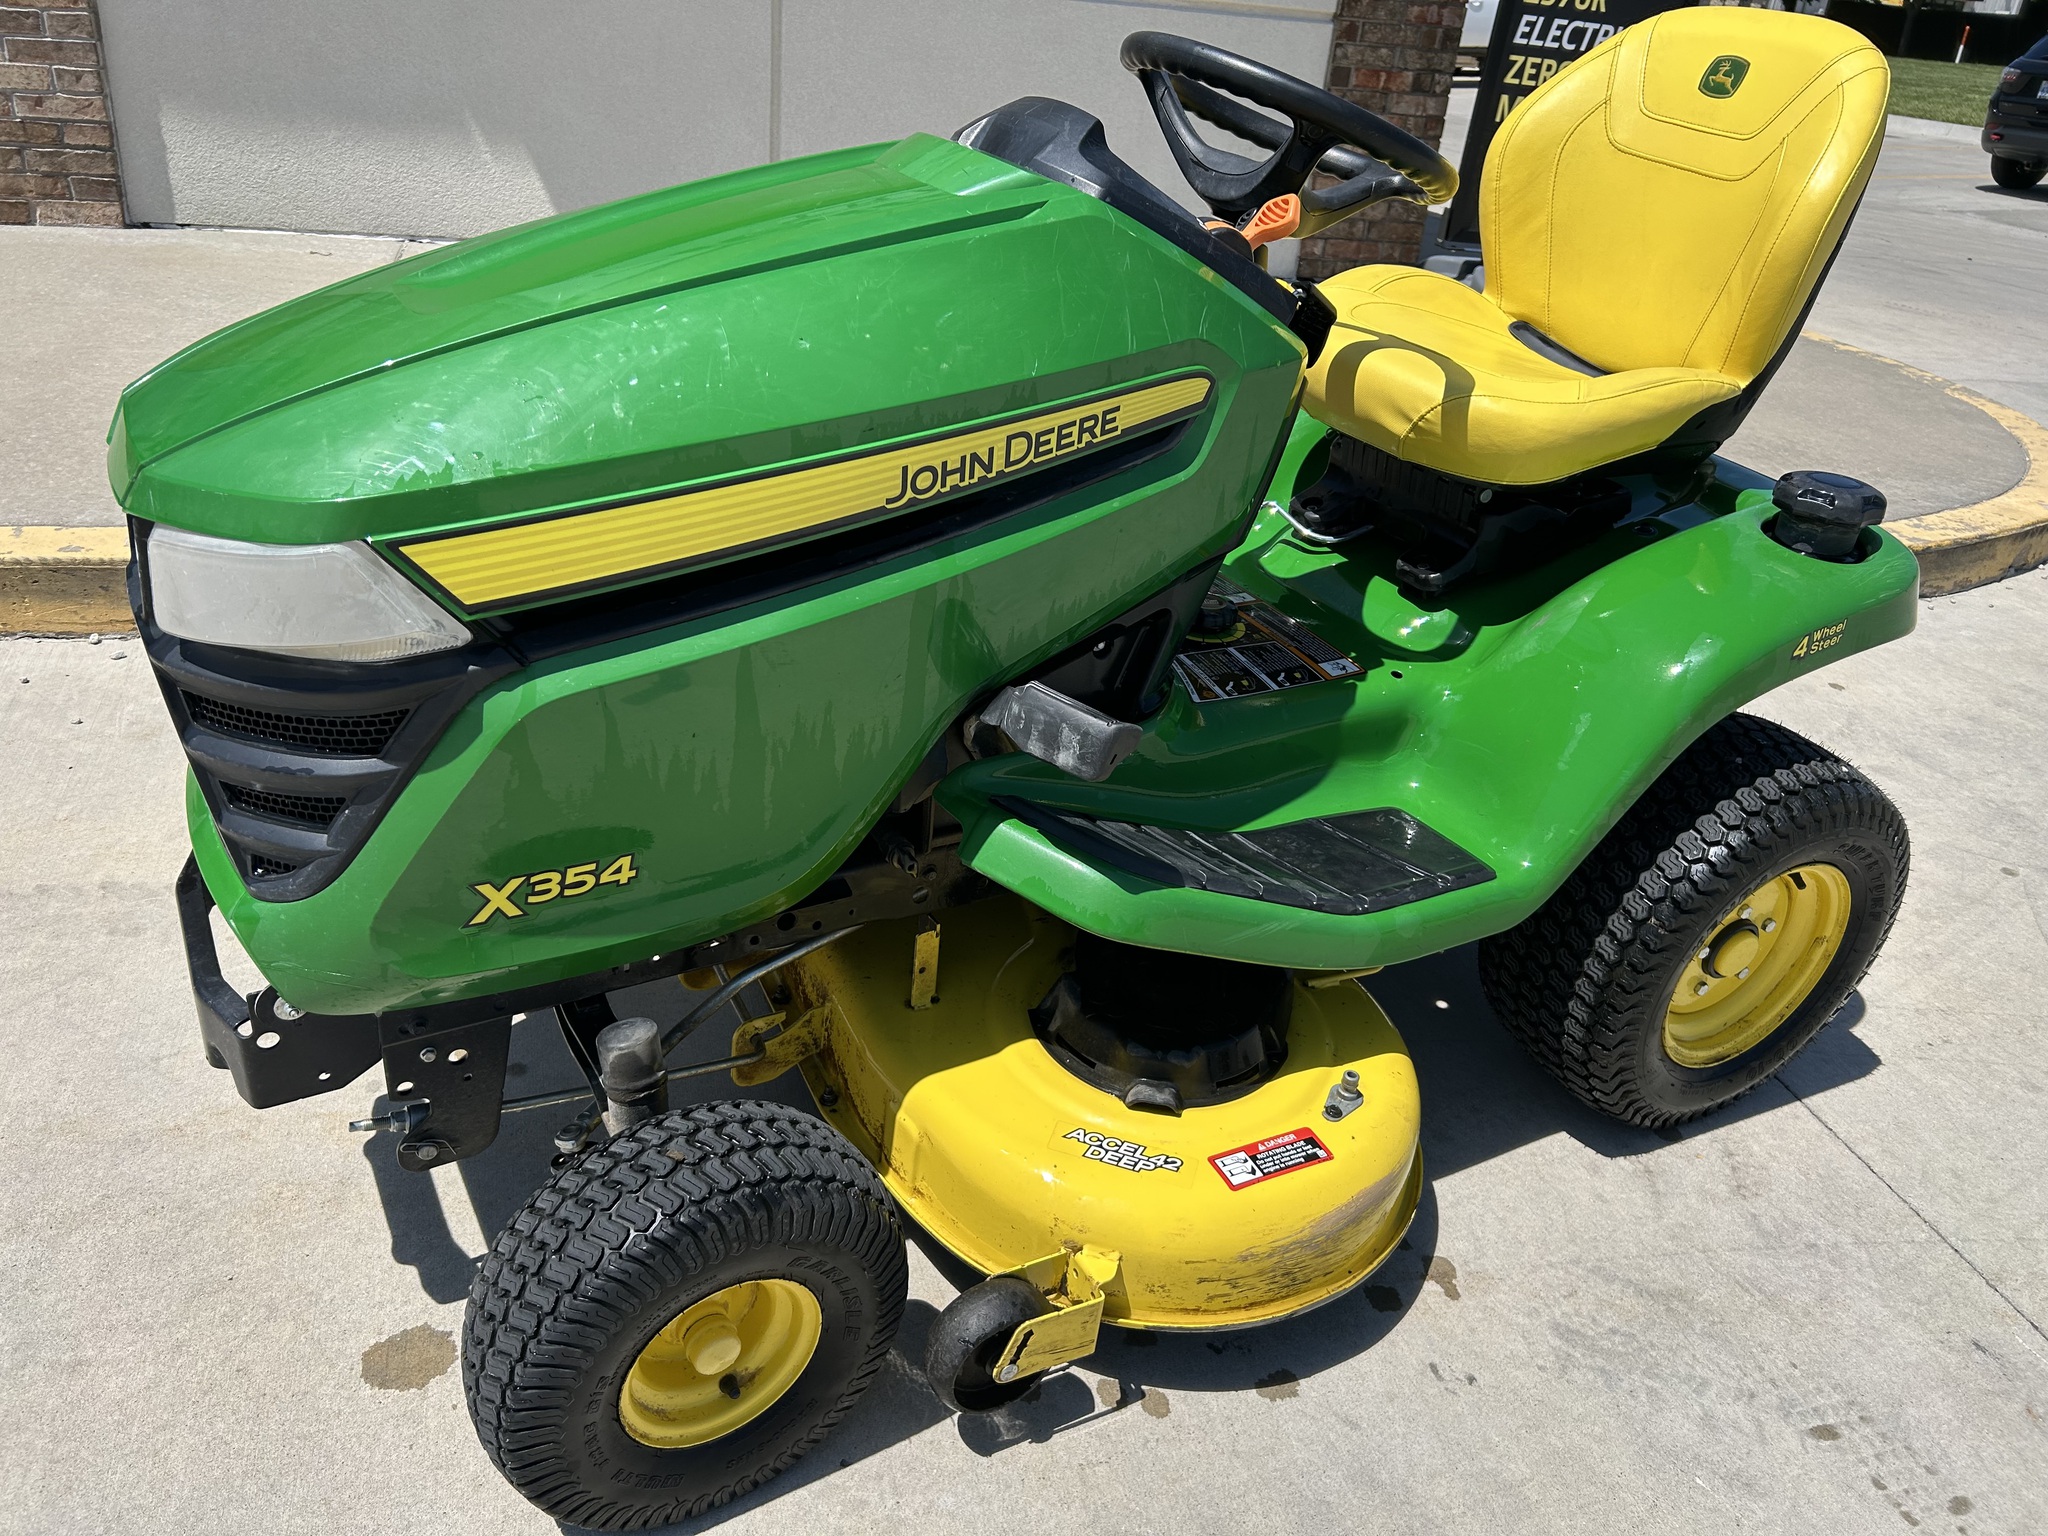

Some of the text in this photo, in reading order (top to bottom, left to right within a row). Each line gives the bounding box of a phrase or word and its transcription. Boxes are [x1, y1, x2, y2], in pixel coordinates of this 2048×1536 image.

[1513, 14, 1624, 51] ELECTR
[1503, 55, 1572, 86] ZER
[885, 405, 1122, 507] JOHN DEERE
[1792, 618, 1848, 658] 4 Wheel
[1809, 633, 1843, 655] Steer
[463, 854, 638, 927] X354
[1062, 1128, 1149, 1162] ACCEL
[1256, 1140, 1306, 1160] ROTATING BLADE
[1264, 1133, 1297, 1148] DANGER
[1082, 1145, 1184, 1173] DEEP 42
